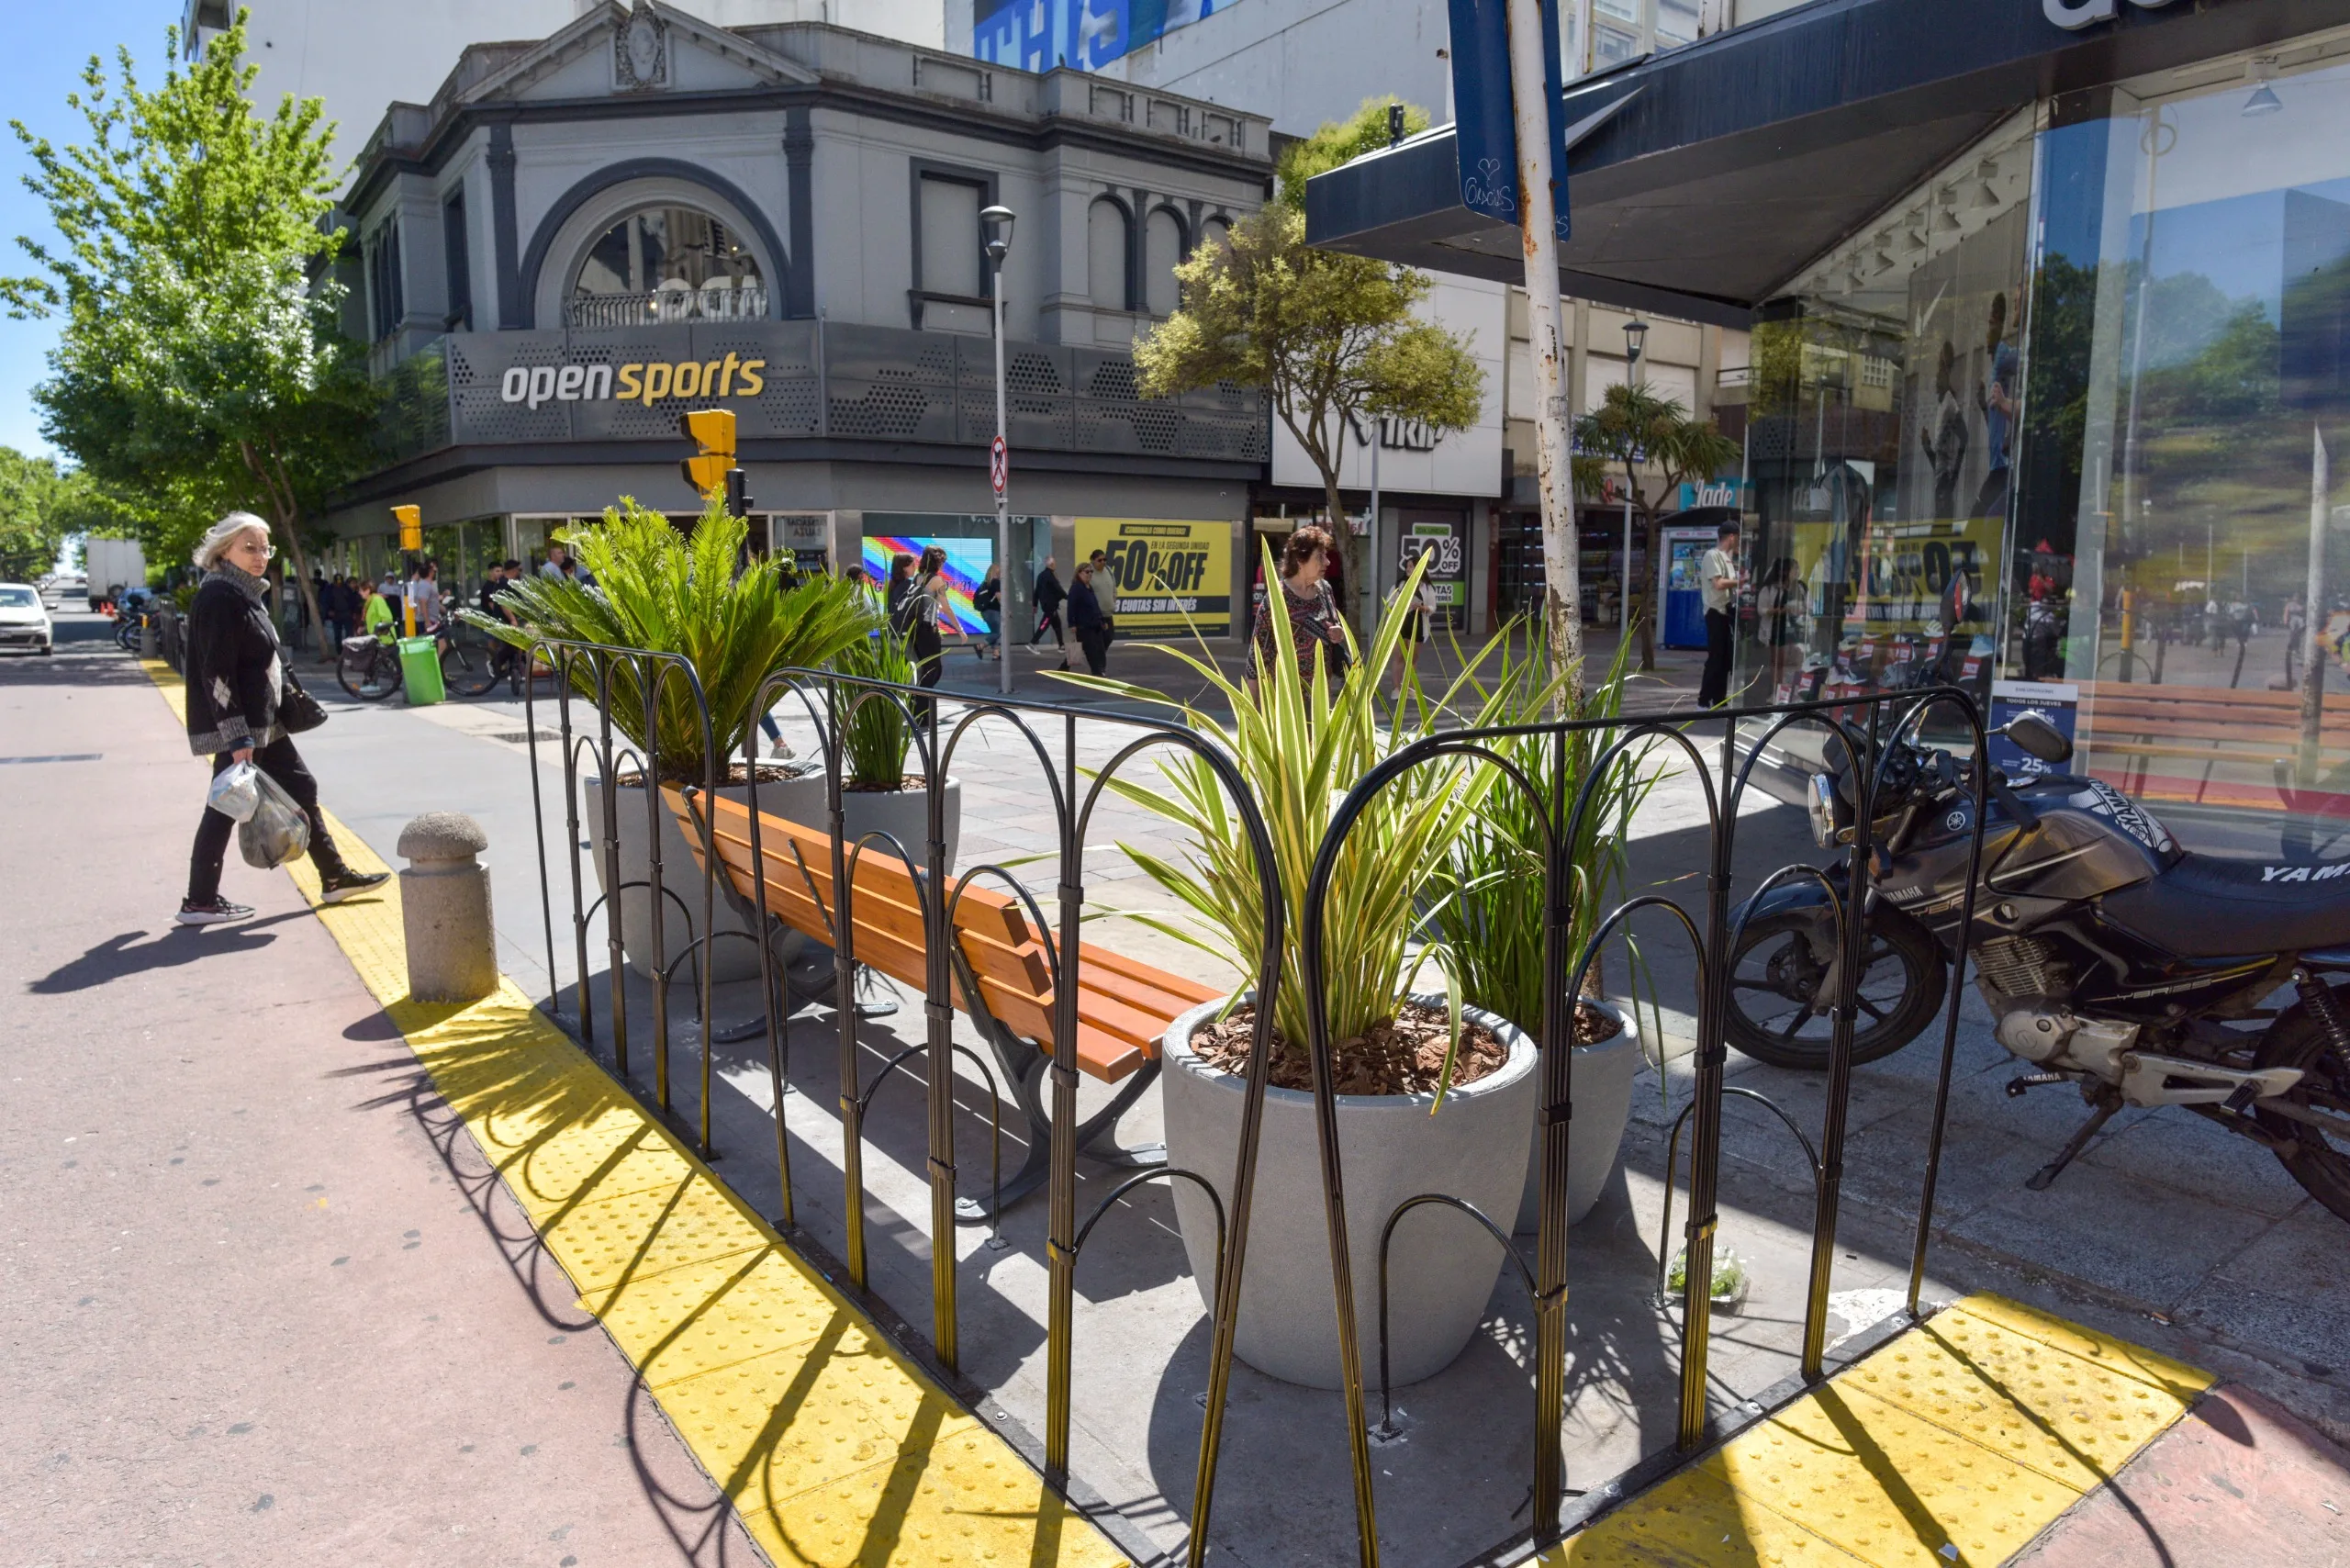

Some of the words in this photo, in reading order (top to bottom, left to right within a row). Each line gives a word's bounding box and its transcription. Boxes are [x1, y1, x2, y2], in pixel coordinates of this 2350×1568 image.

[1166, 541, 1190, 550] SEGUNDA
[1191, 542, 1210, 550] UNIDAD
[1121, 599, 1151, 612] CUOTAS
[1152, 599, 1167, 612] SIN
[2020, 757, 2053, 774] 25%
[2261, 862, 2350, 881] YAM
[1885, 885, 1924, 902] YAMAHA
